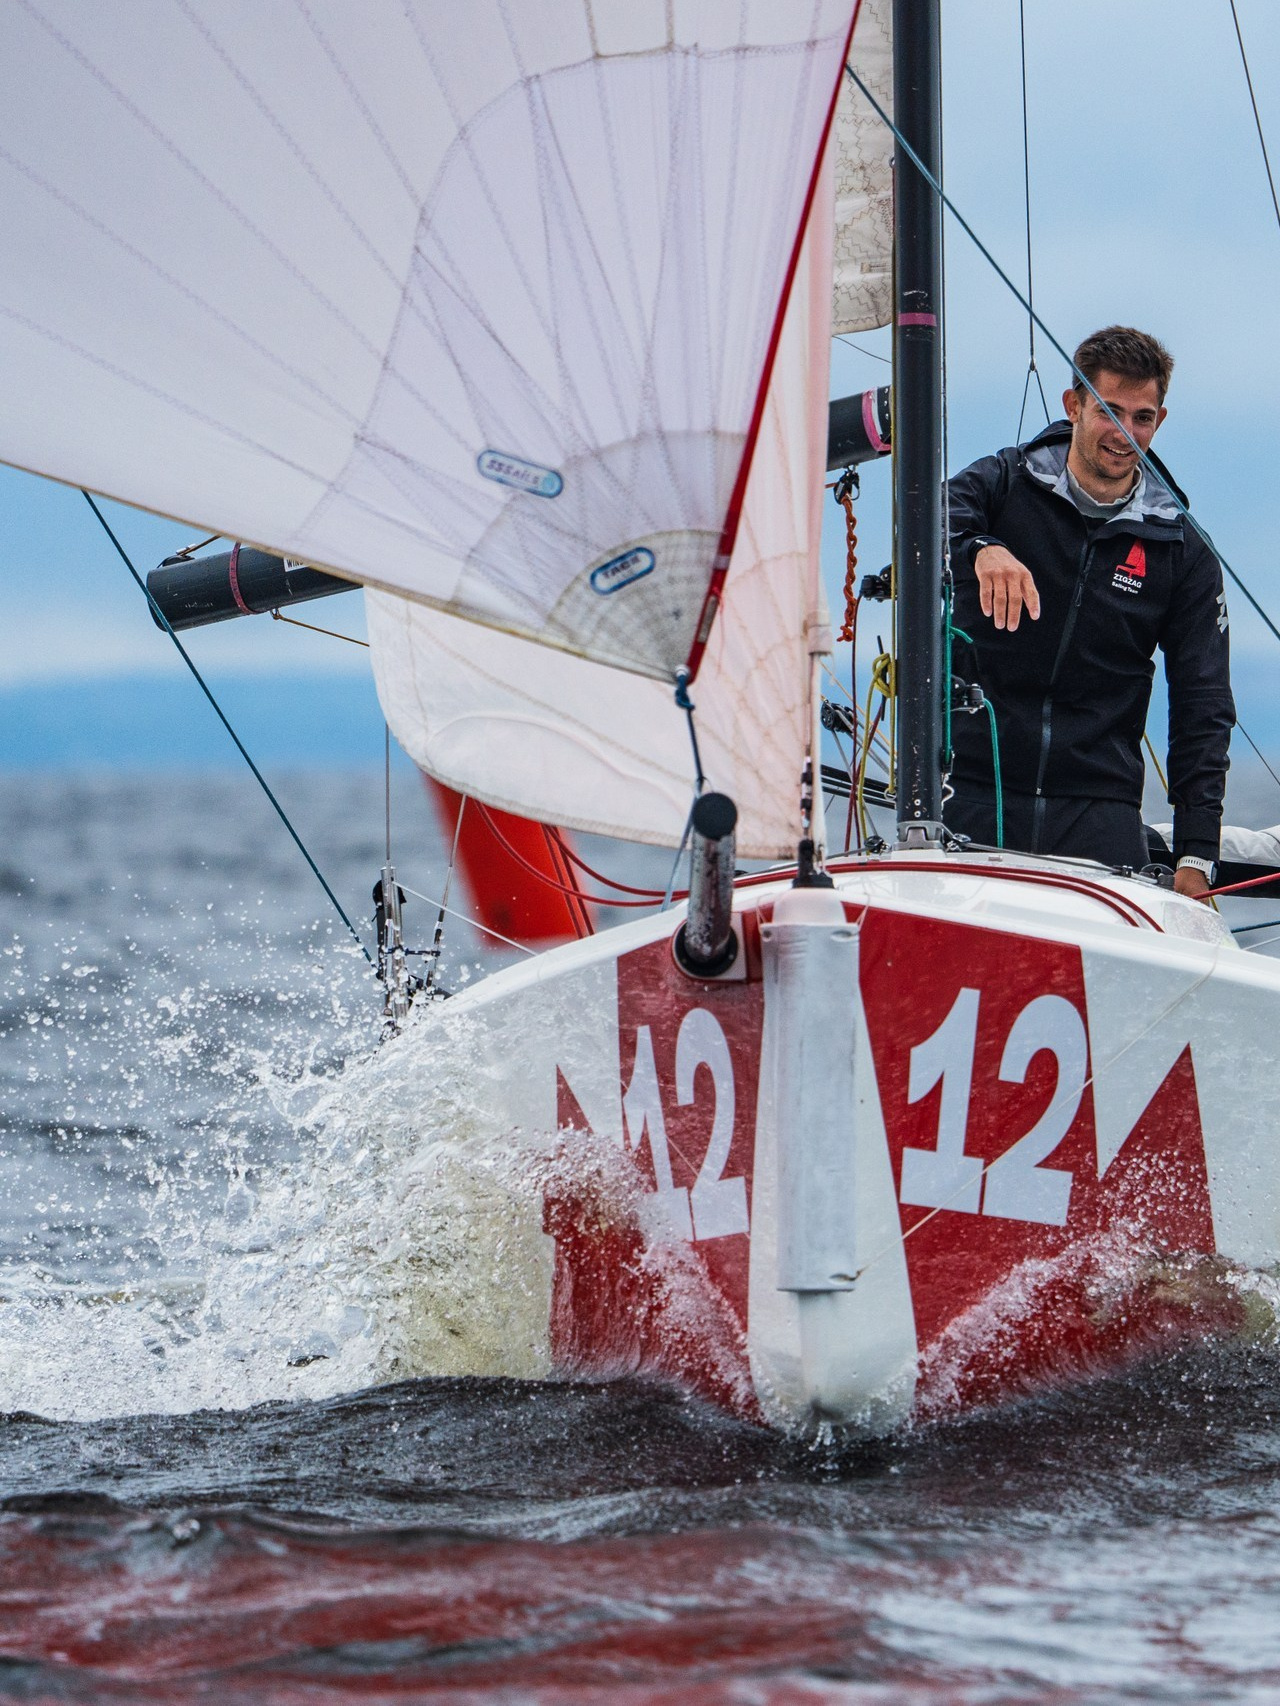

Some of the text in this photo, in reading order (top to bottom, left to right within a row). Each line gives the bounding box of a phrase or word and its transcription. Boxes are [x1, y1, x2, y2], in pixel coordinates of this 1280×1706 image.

[1113, 573, 1142, 588] ZIGZAG
[622, 1006, 750, 1241] 12
[900, 987, 1088, 1227] 12
